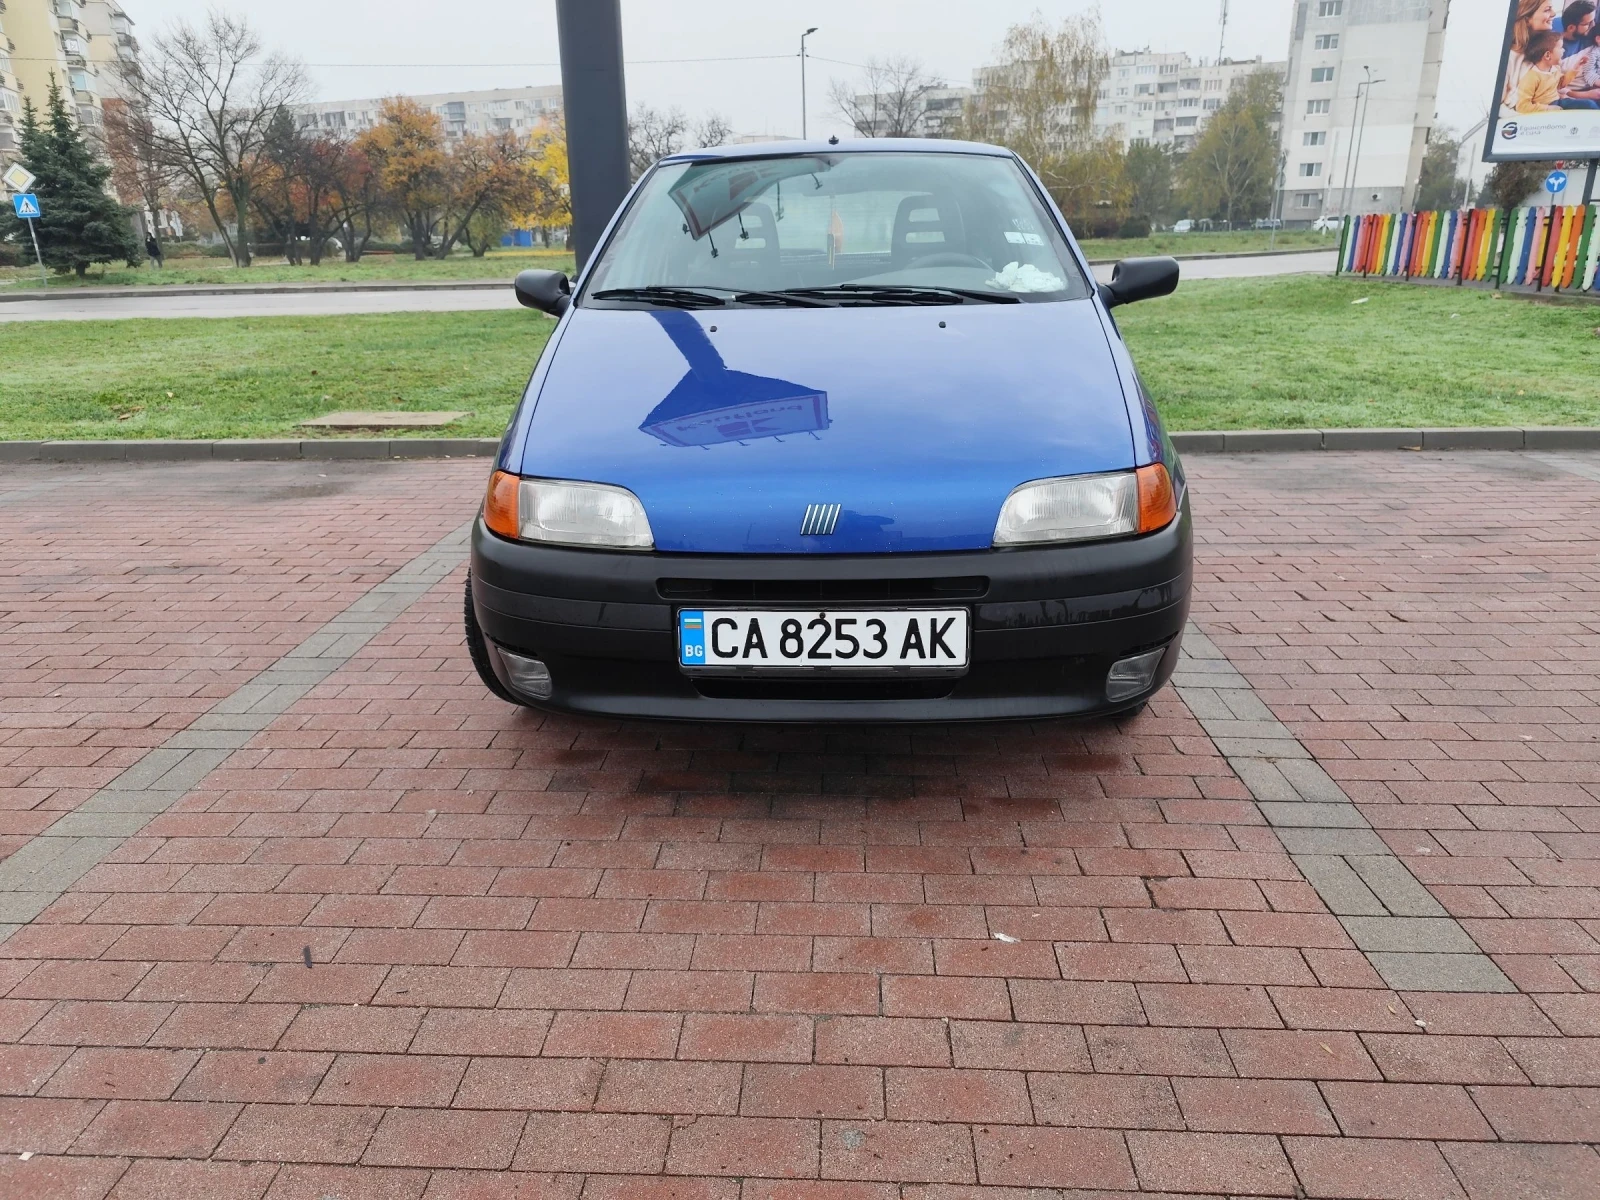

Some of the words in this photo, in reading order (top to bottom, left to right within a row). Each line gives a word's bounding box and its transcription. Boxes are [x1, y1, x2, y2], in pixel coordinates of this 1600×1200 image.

[684, 645, 703, 657] BG
[711, 617, 768, 659] CA
[779, 617, 888, 659] 8253
[899, 617, 957, 659] AK
